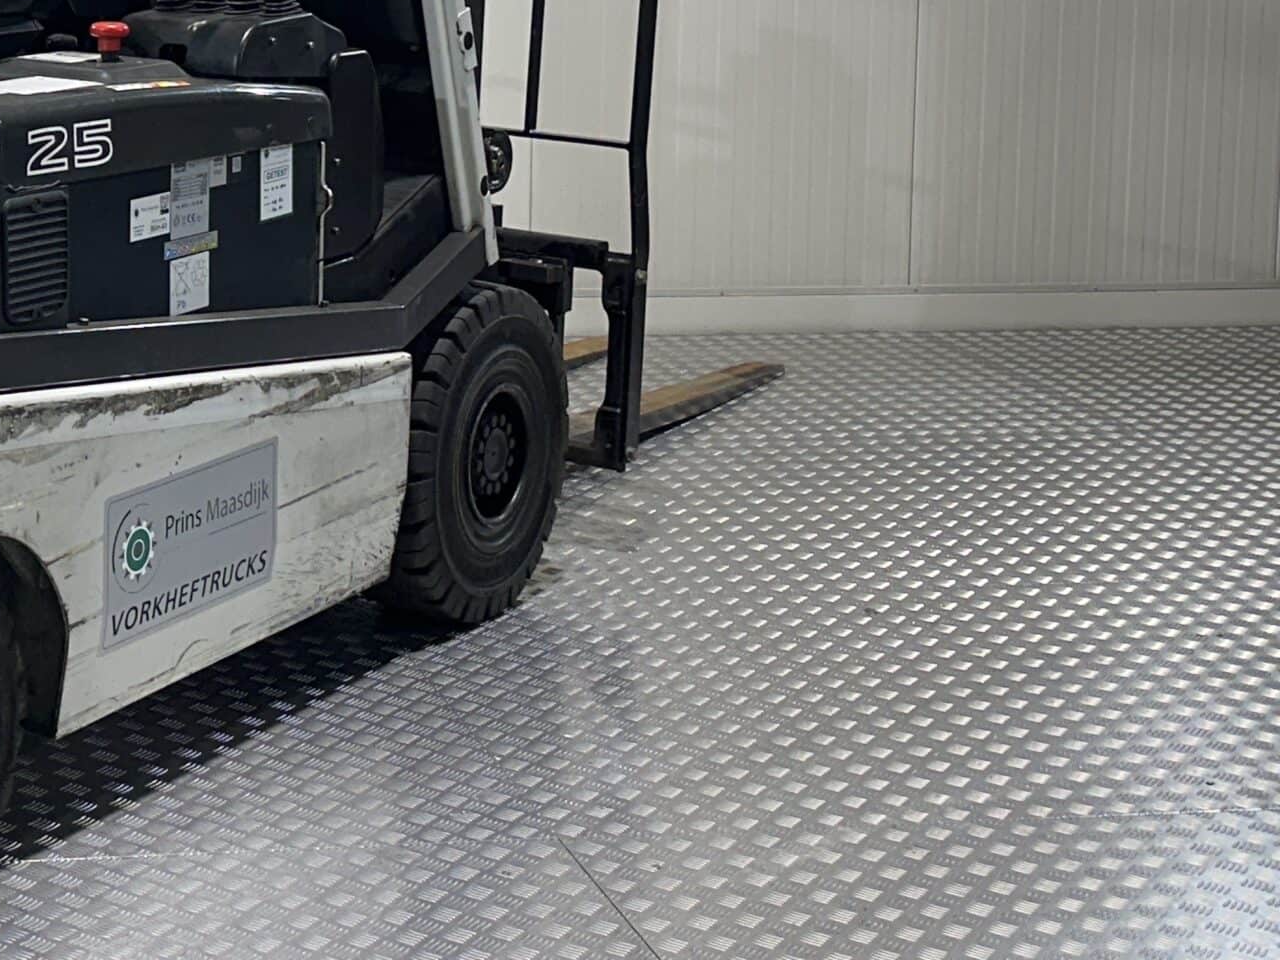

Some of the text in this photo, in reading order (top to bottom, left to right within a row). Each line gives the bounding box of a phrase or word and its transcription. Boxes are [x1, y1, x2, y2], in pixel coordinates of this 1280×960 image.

[27, 118, 113, 176] 25
[165, 478, 270, 539] Prins Maasdijk
[111, 549, 268, 637] VORKHEFTRUCKS
